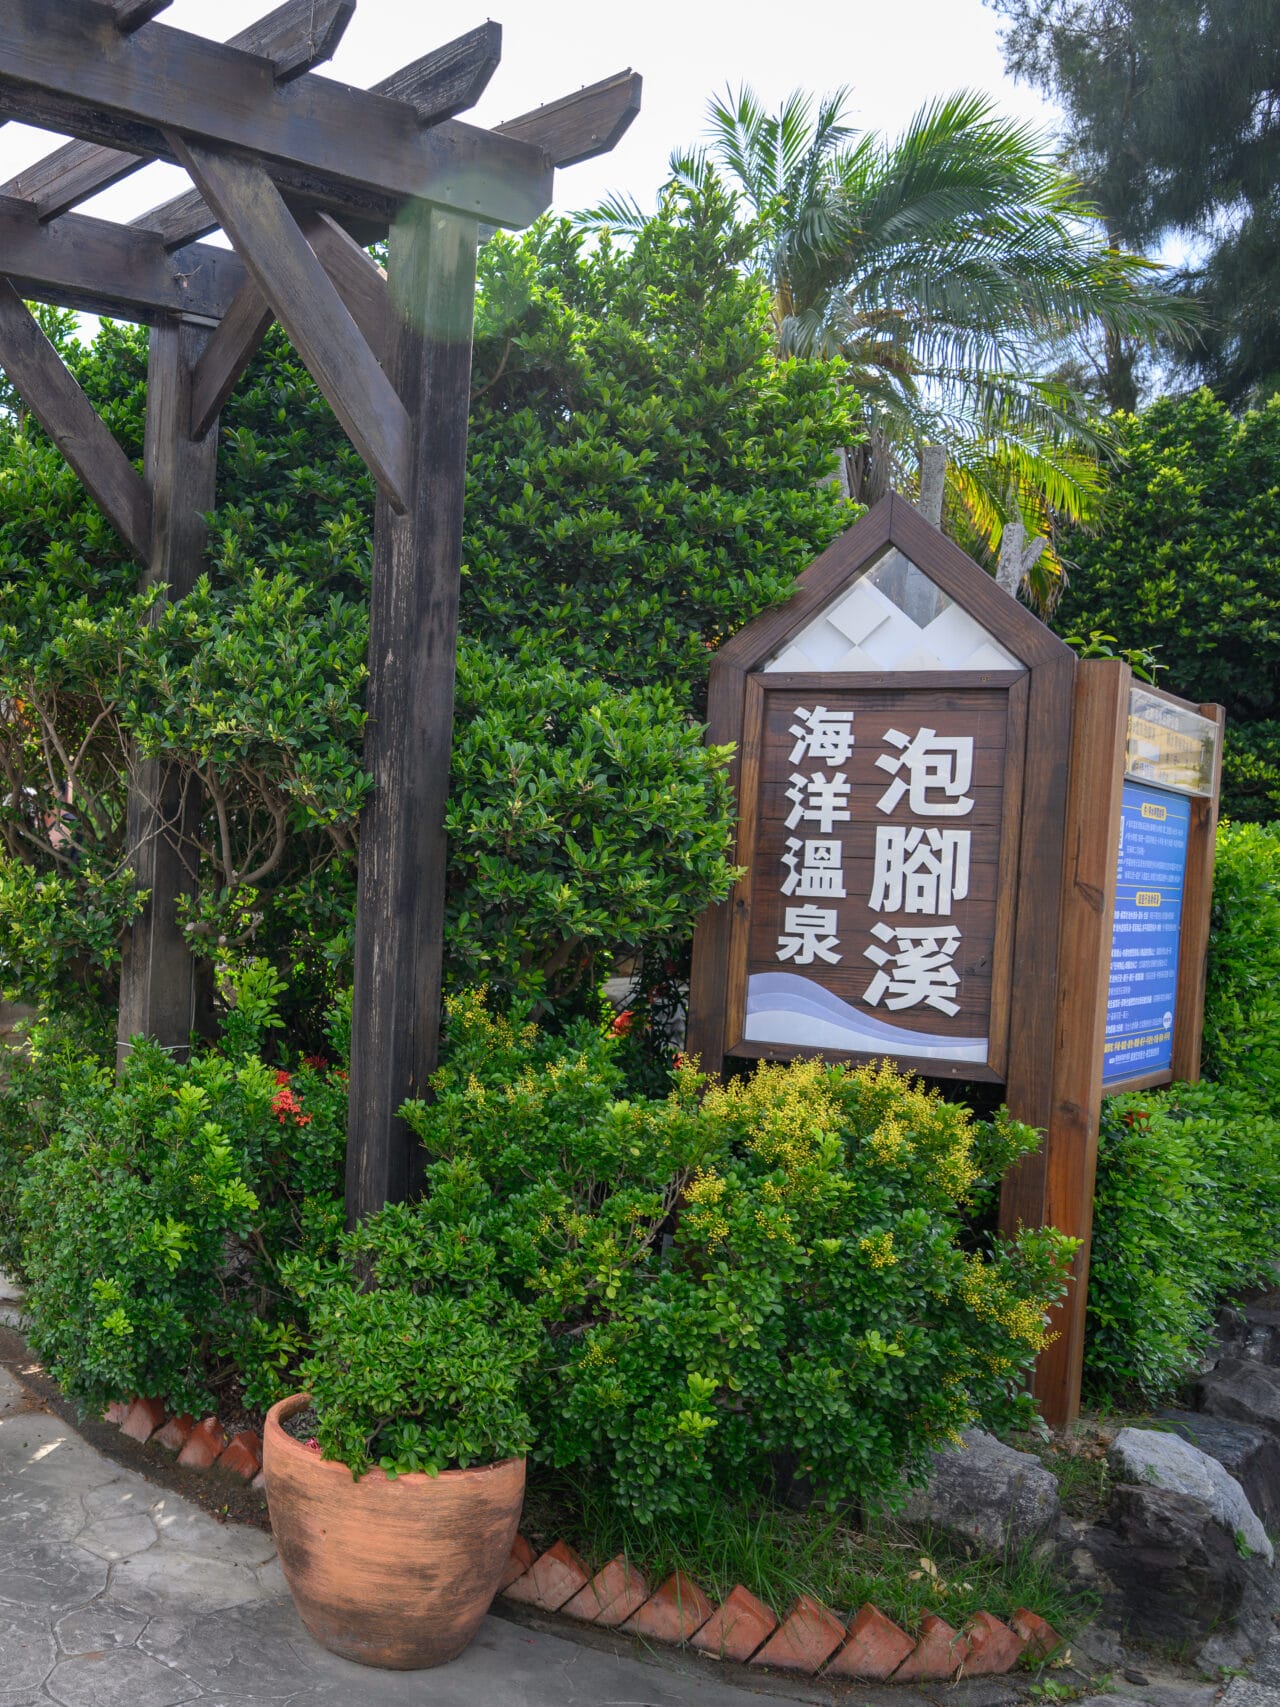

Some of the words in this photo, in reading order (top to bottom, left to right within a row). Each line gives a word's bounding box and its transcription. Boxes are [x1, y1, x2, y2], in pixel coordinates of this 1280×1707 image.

[775, 705, 855, 965] 海洋溫泉
[862, 727, 975, 1017] 泡腳溪
